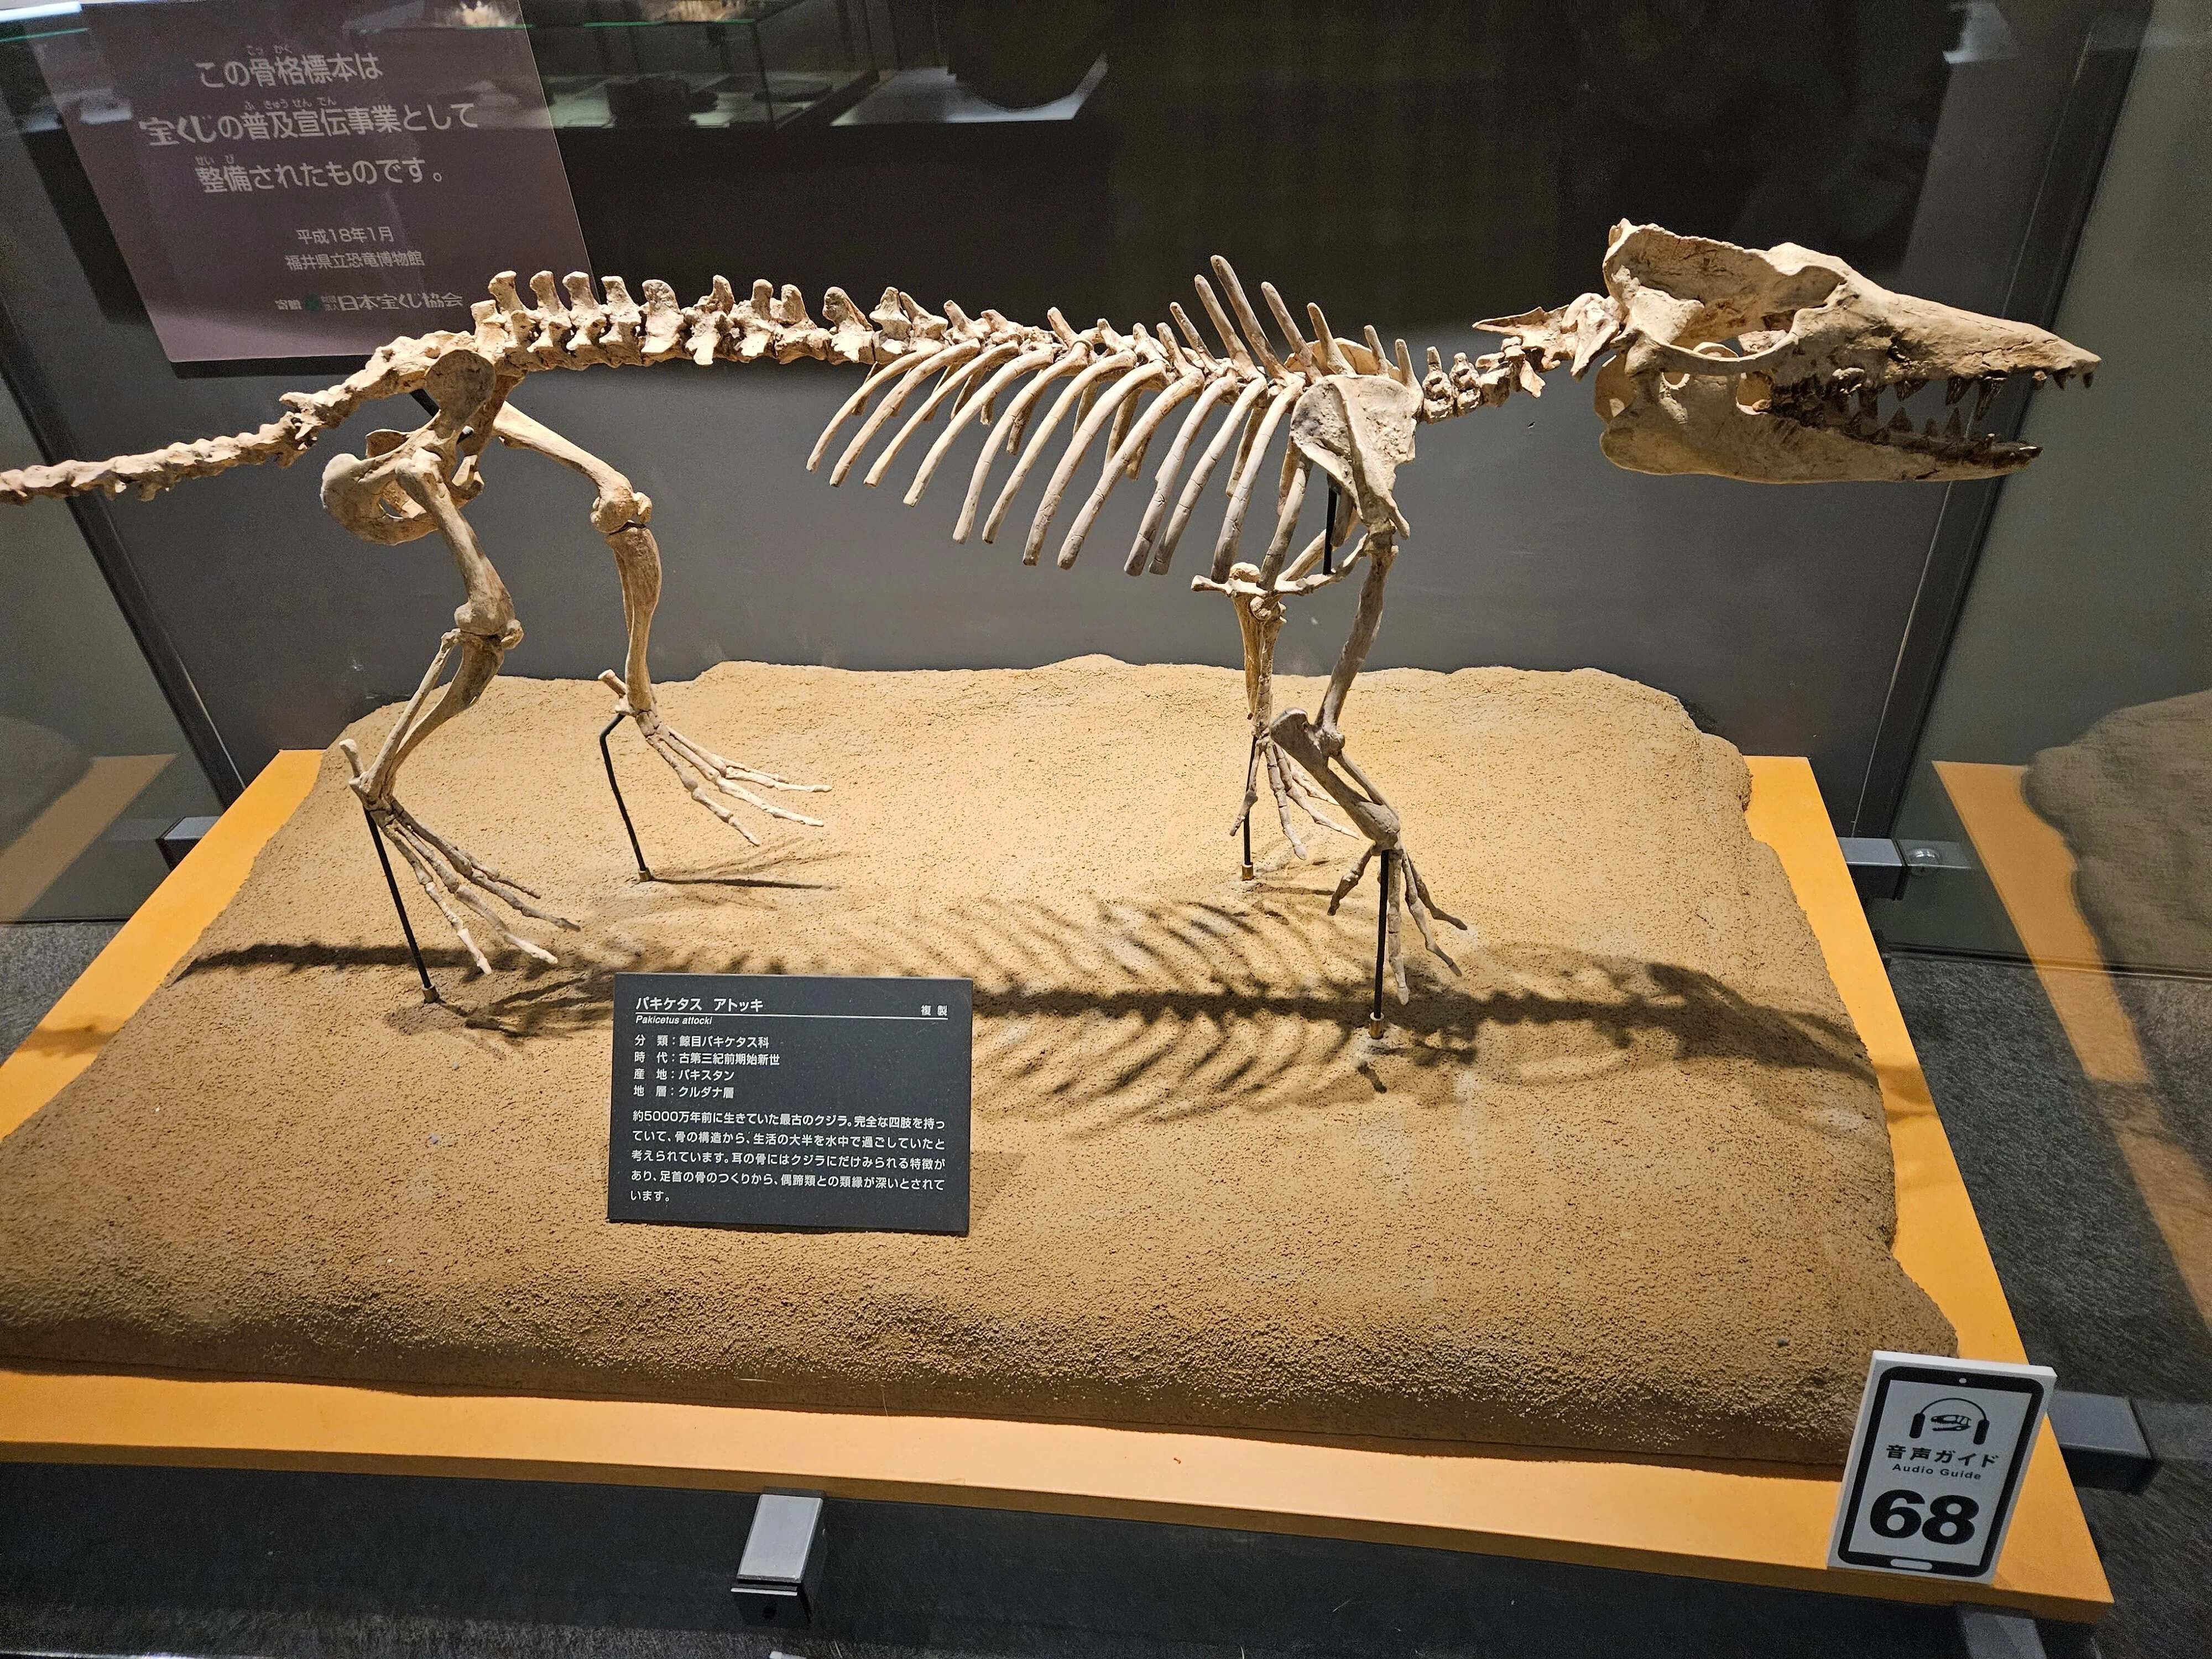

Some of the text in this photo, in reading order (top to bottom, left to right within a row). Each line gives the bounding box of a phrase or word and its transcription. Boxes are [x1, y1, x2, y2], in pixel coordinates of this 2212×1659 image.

[195, 53, 383, 88] この骨格標本は
[139, 102, 479, 146] 宝くじの普及宣伝事業として
[195, 158, 443, 193] 整備されたものです。
[296, 226, 394, 244] 平成18年1月
[284, 251, 425, 270] 福井県立恐竜博物館
[635, 996, 702, 1011] パキケタス
[713, 998, 764, 1013] アトッキ
[635, 1015, 712, 1025] Pakicetus attocki
[630, 1190, 670, 1202] います。
[1886, 1444, 1999, 1468] 音声ガイド
[1892, 1463, 1981, 1480] Audio Guide
[1869, 1489, 1980, 1545] 68
